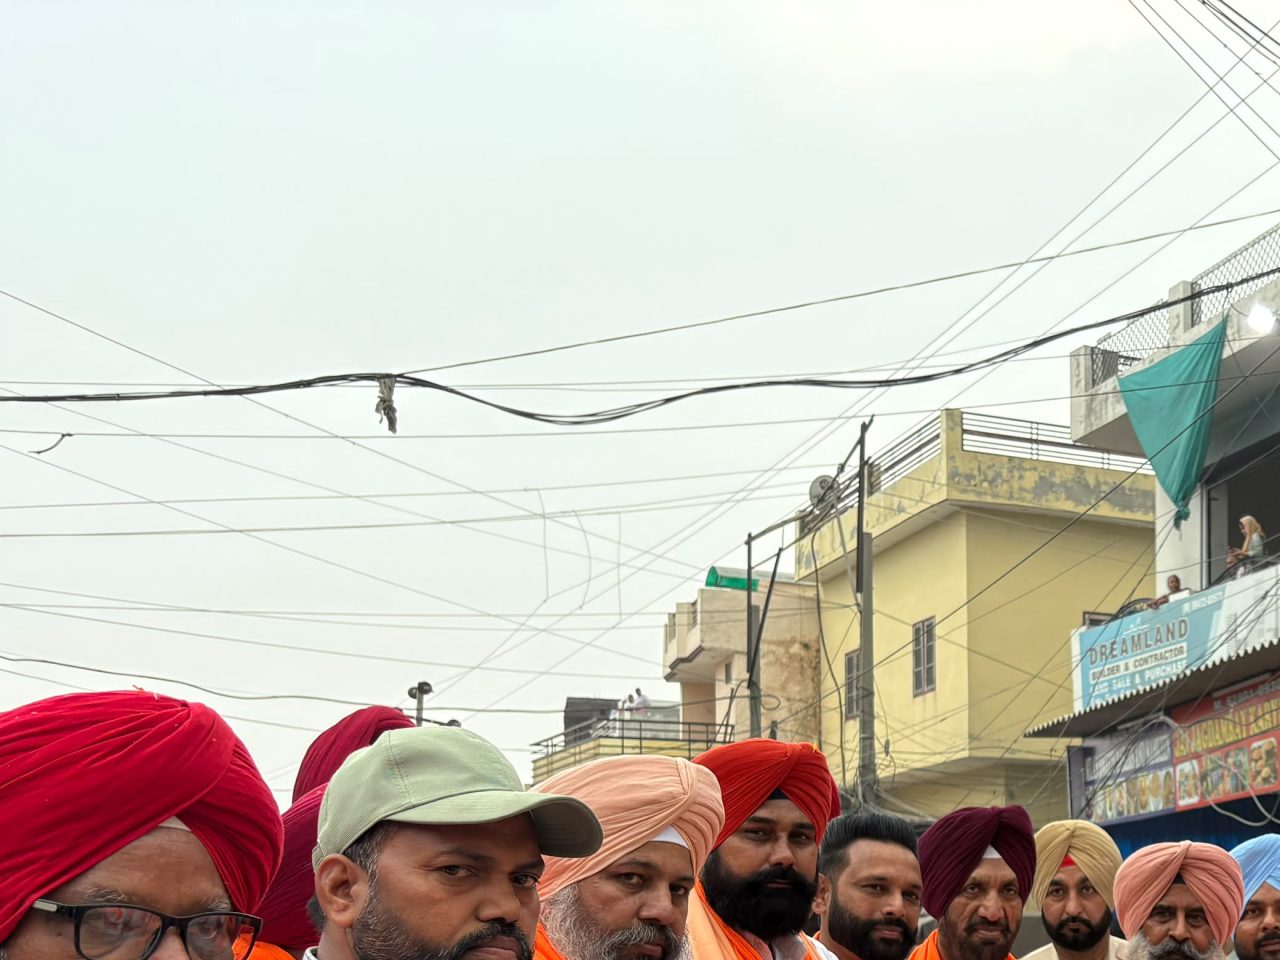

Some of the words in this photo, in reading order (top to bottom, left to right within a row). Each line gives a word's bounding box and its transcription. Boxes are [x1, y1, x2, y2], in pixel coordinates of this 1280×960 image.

[1089, 618, 1189, 667] DREAMLAND
[1091, 664, 1121, 681] BUILDER
[1133, 645, 1185, 668] CONTRACTOR
